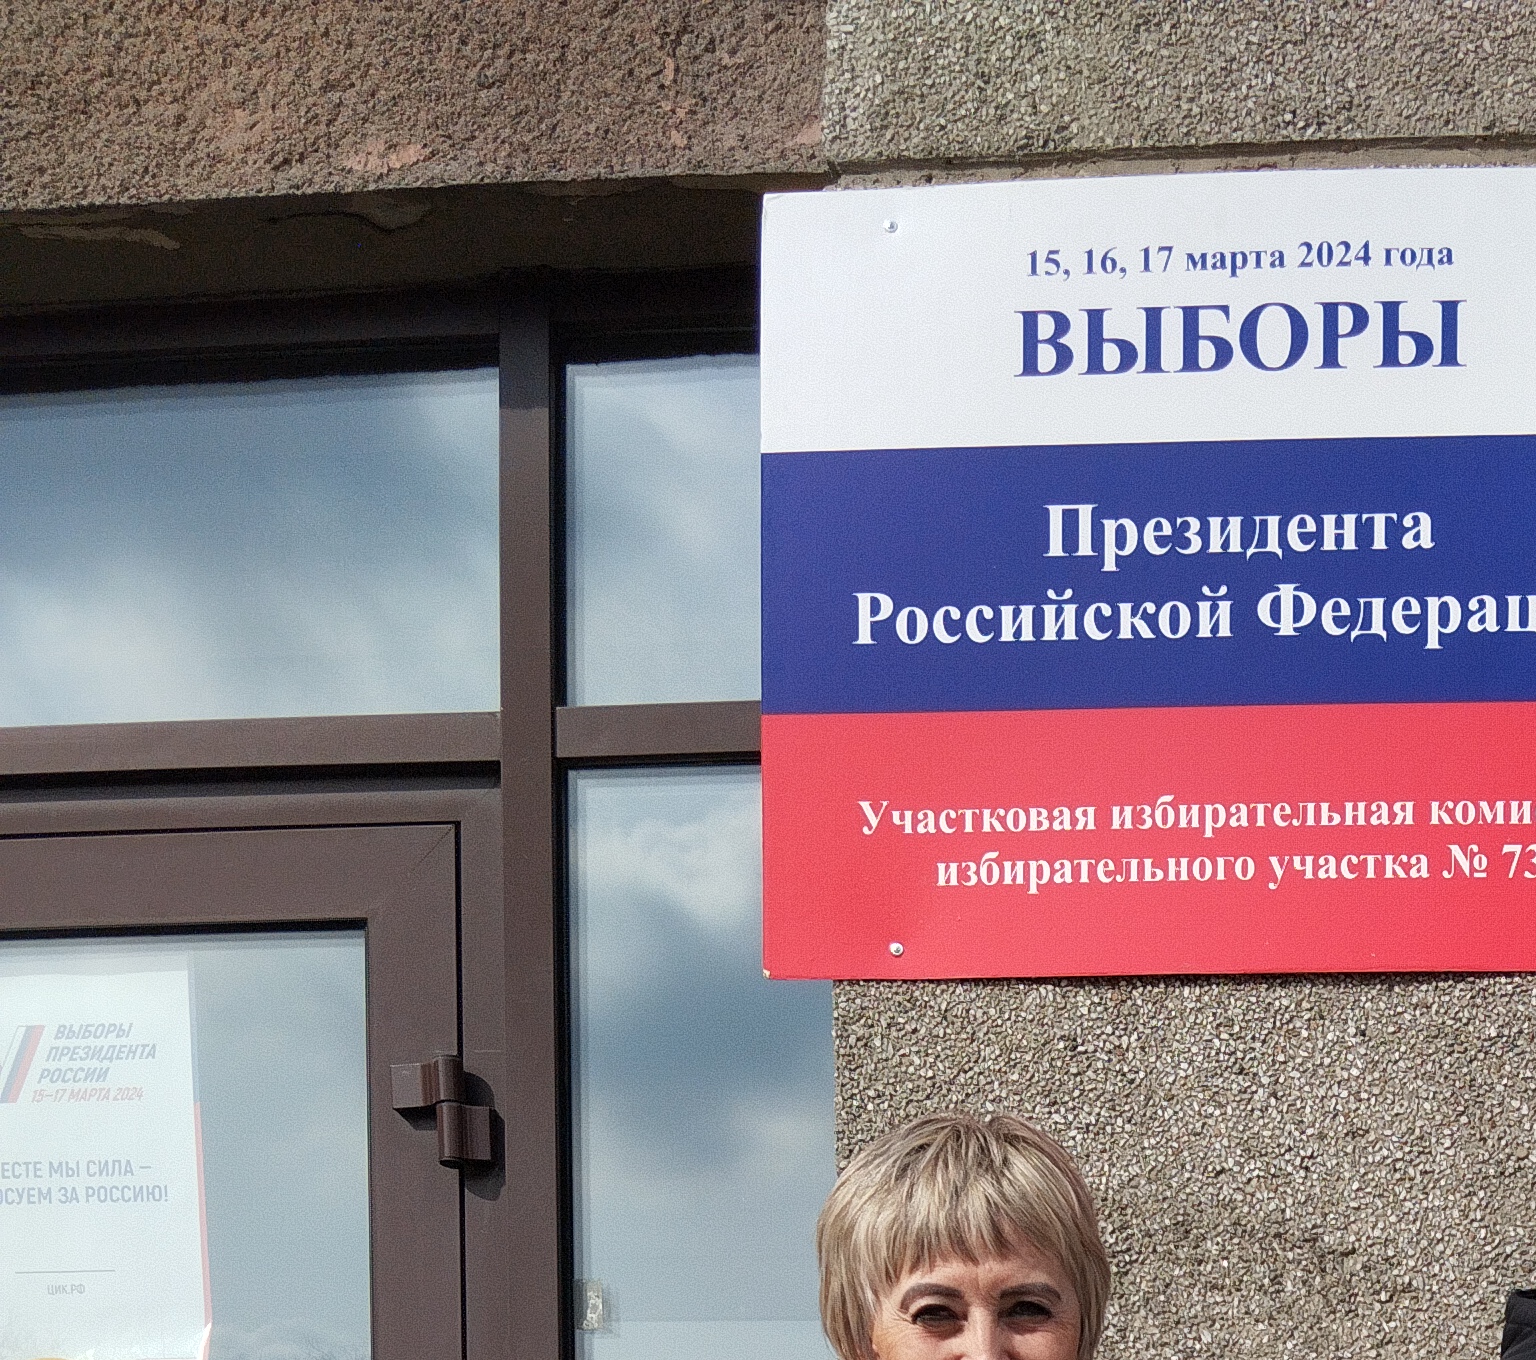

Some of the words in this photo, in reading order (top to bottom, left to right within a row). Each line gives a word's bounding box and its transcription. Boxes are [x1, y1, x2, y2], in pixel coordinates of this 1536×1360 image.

[1029, 249, 1071, 279] 15,
[1085, 248, 1127, 275] 16,
[1142, 245, 1174, 273] 17
[1186, 249, 1285, 278] марта
[1298, 240, 1372, 268] 2024
[1384, 246, 1454, 269] года
[1017, 299, 1463, 377] ВЫБОРЫ
[1044, 503, 1435, 572] Президента
[853, 584, 1233, 645] Российской
[858, 800, 1096, 835] Участковая
[1110, 794, 1414, 839] избирательная
[936, 851, 1256, 895] избирательного
[1267, 853, 1430, 890] участка
[1441, 843, 1488, 879] №
[54, 1023, 133, 1040] ВЫБОРЫ
[45, 1044, 157, 1063] ПРЕЗИДЕНТА
[37, 1067, 110, 1084] РОССИИ
[67, 1087, 110, 1102] МАРТА
[112, 1086, 144, 1102] 2024
[1, 1161, 43, 1180] ЕСТЕ
[48, 1160, 80, 1179] МЫ
[86, 1159, 135, 1178] СИЛА
[0, 1186, 53, 1206] СУЕМ
[58, 1186, 80, 1204] ЗА
[85, 1184, 169, 1204] РОССИЮ!
[47, 1283, 86, 1296] ЦИК.РФ
